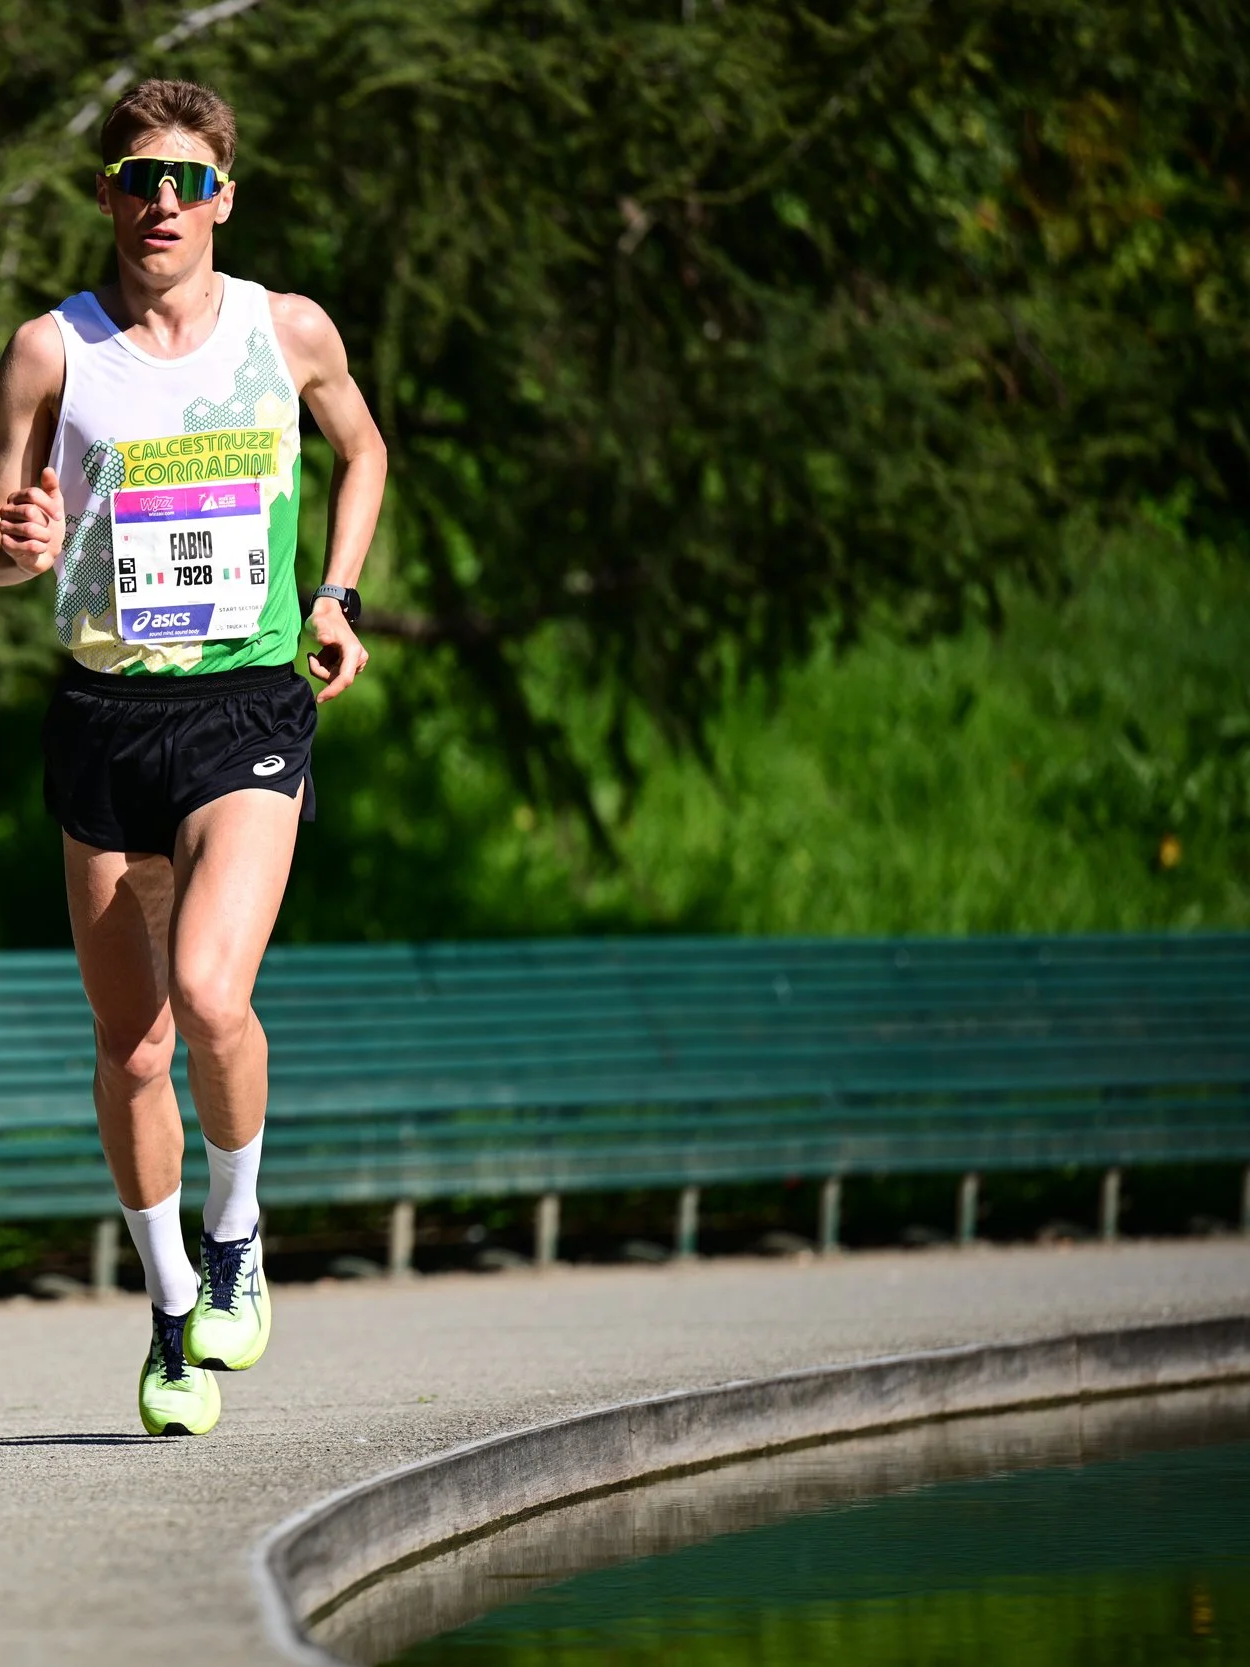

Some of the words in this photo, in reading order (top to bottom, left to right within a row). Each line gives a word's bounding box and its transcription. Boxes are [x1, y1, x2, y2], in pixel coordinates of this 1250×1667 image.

[128, 432, 274, 461] CALCESTRUZZI
[129, 453, 272, 486] CORRADINI
[170, 530, 213, 561] FABIO
[174, 565, 213, 586] 7928
